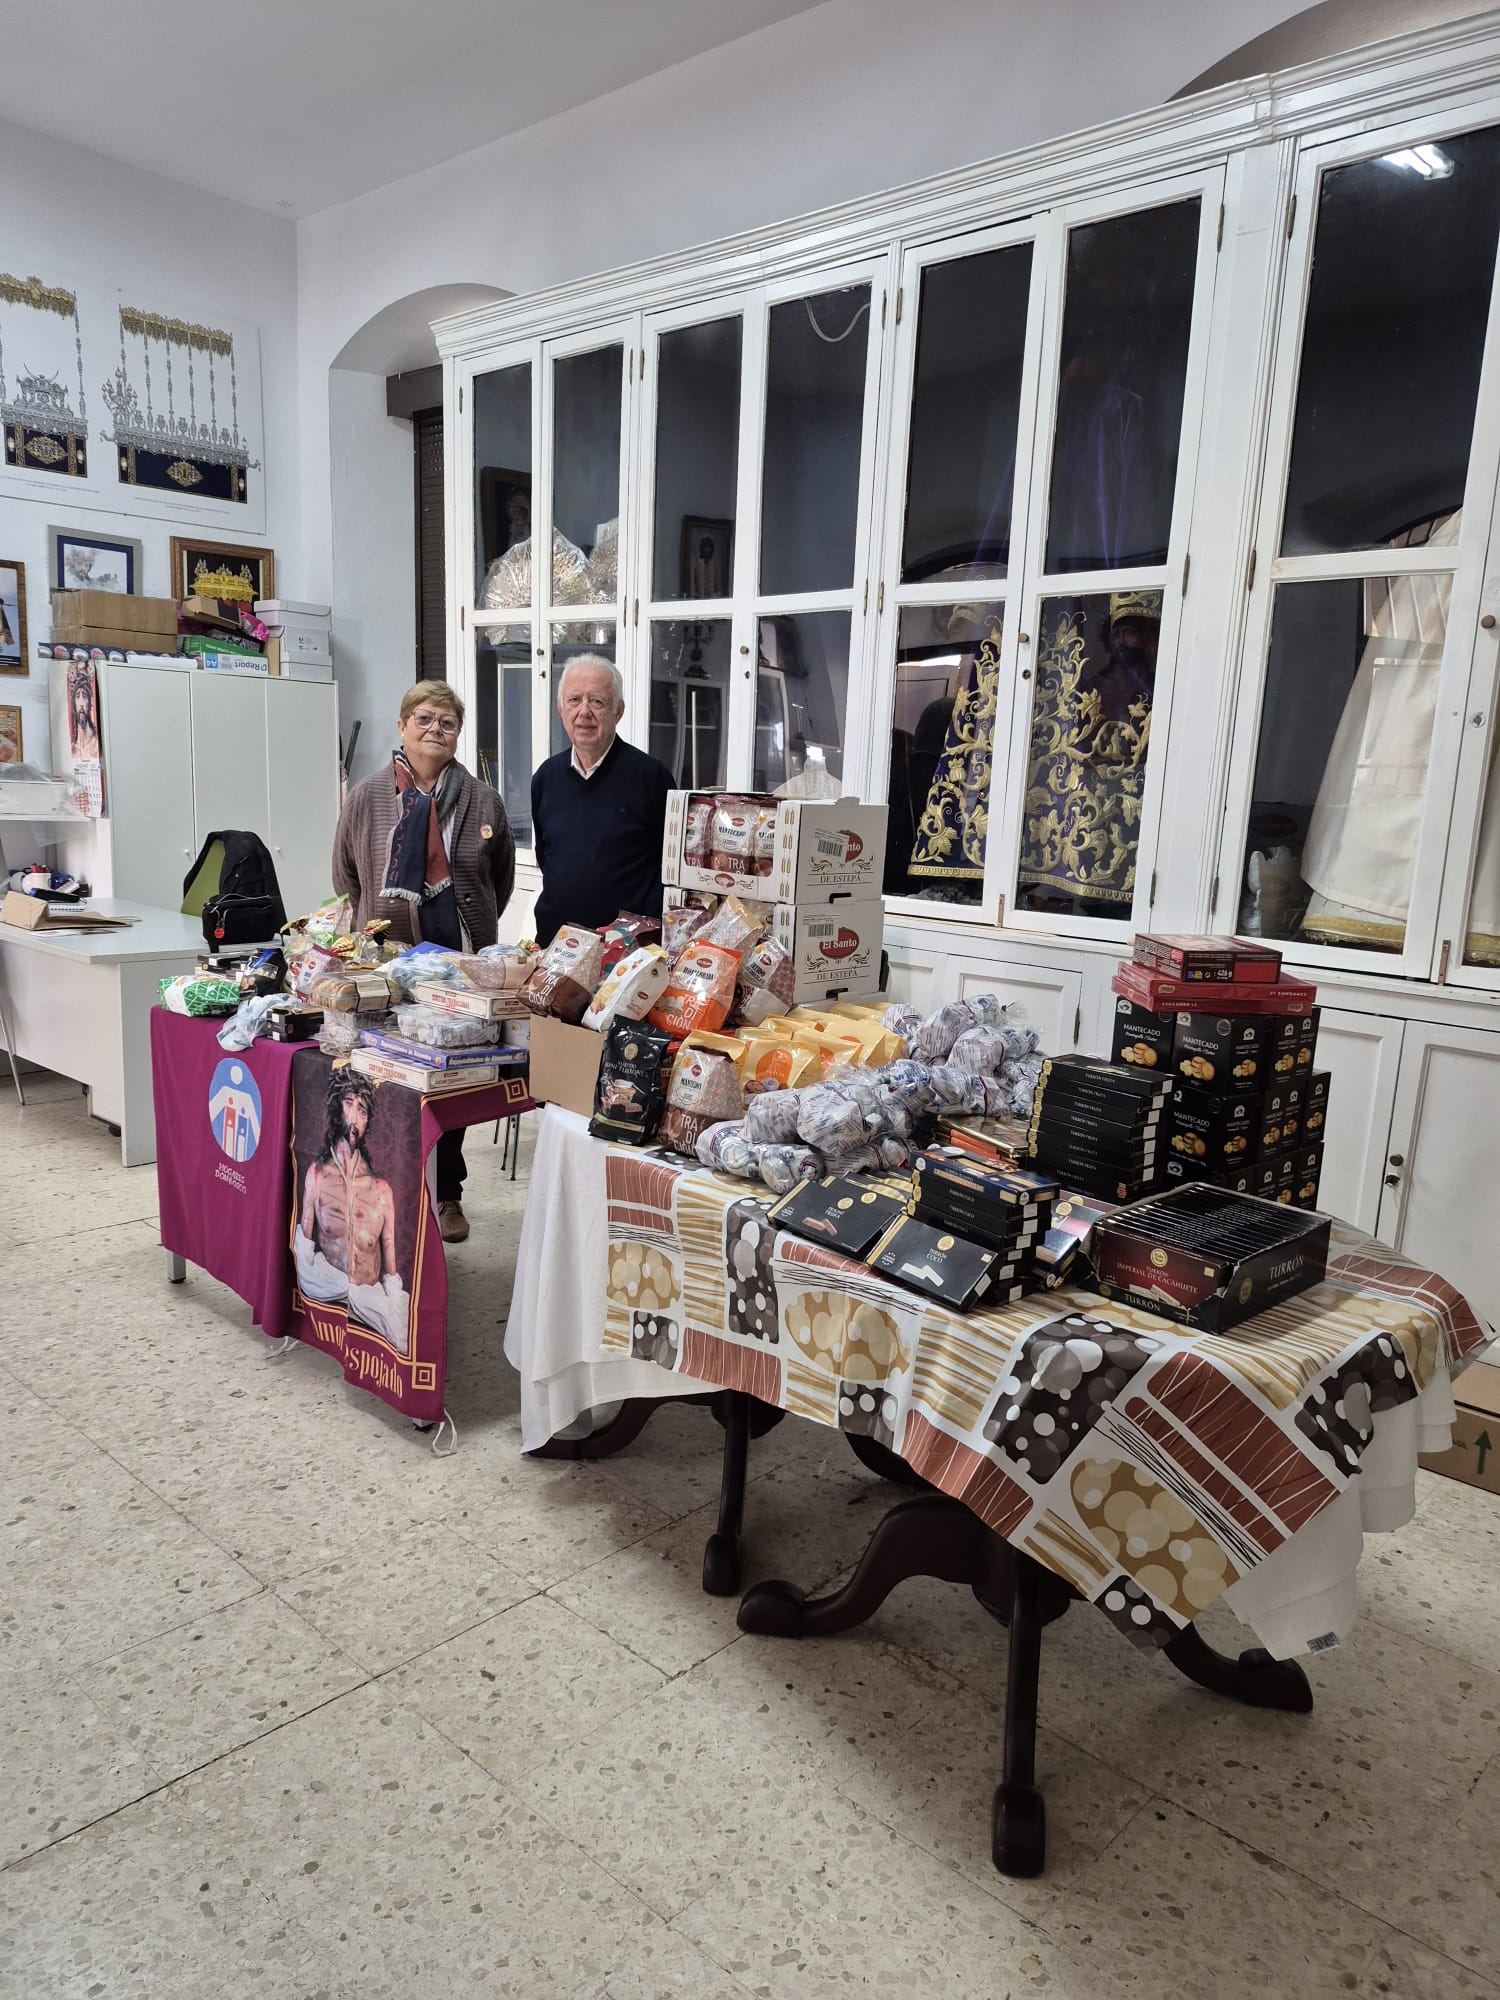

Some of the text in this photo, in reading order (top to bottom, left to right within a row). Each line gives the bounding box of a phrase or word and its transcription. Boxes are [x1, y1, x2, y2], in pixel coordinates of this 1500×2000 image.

[233, 661, 261, 671] Report
[727, 857, 745, 870] TRA
[820, 874, 862, 884] DE ESTEPA
[822, 938, 858, 950] El Santo
[816, 969, 858, 981] DE ESTEPA
[1123, 1022, 1161, 1037] MANTECADO
[1182, 1035, 1219, 1050] MANTECADO
[680, 1113, 698, 1131] TRA
[1173, 1110, 1210, 1128] MANTECADO
[926, 1252, 943, 1264] COCO
[1269, 1254, 1306, 1281] TURRÓN
[1116, 1261, 1199, 1295] IMPERIAL DE CACAHUETE
[1124, 1292, 1161, 1313] TURRÓN
